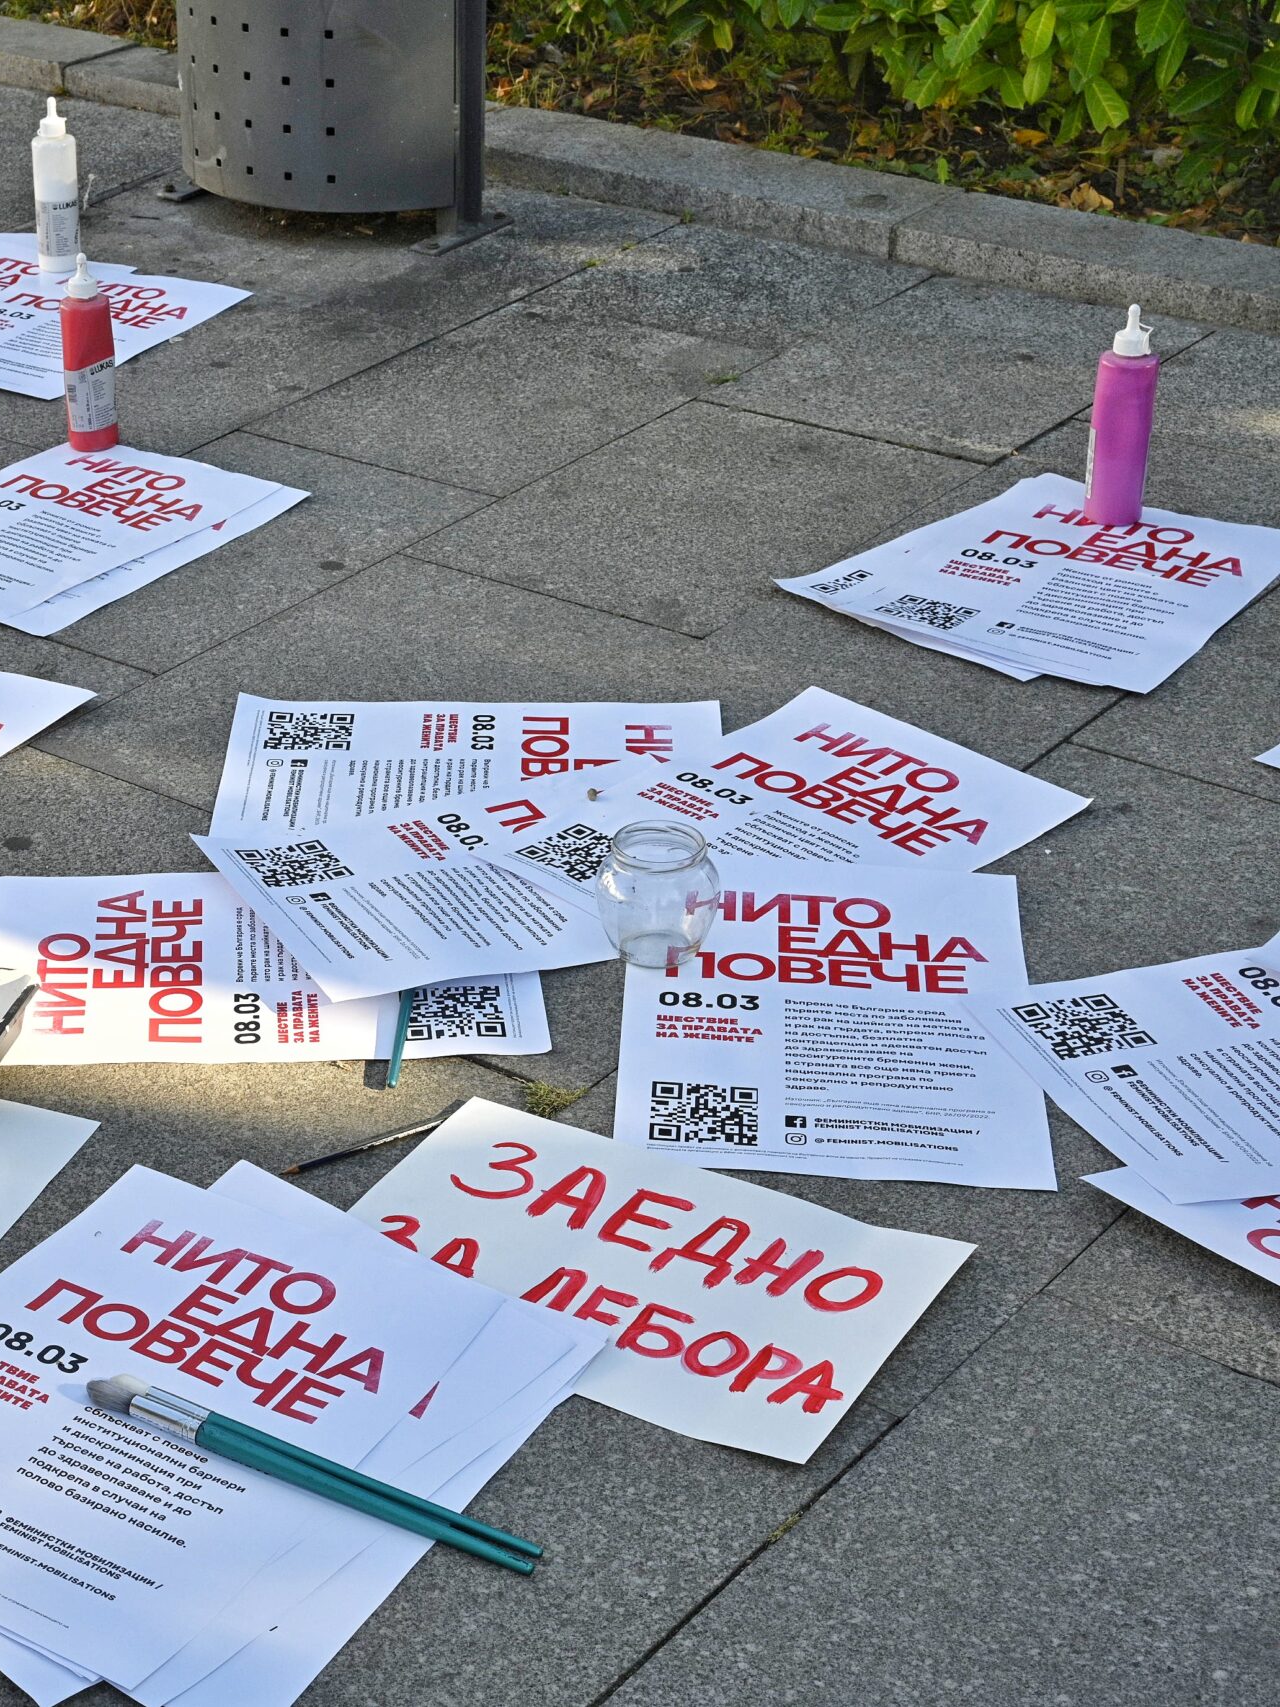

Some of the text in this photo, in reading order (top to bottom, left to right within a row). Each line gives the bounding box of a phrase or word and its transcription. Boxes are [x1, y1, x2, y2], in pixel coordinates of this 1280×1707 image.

[94, 359, 114, 374] LUKAS
[64, 454, 186, 492] НИТО
[89, 477, 205, 521] ЕДНА
[949, 560, 1009, 574] ШЕСТВИЕ
[960, 548, 1036, 570] 08.03
[981, 530, 1221, 588] ПОВЕЧЕ
[1082, 531, 1244, 577] ЕДНА
[954, 573, 1011, 586] ЖЕНИТЕ
[962, 568, 1020, 583] ПРАВАТА
[420, 714, 433, 748] НА ЖЕНИТЕ
[433, 714, 446, 751] ЗА ПРАВАТА
[448, 714, 459, 743] ШЕСТВИЕ
[471, 714, 495, 750] 08.03
[521, 716, 571, 782] ПОВ
[793, 722, 960, 793] НИТО
[637, 791, 706, 821] НА ЖЕНИТЕ
[647, 787, 720, 818] ЗА ПРАВАТА
[656, 782, 715, 807] ШЕСТВИЕ
[676, 772, 754, 805] 08.03
[710, 751, 952, 857] ПОВЕЧЕ
[823, 765, 990, 846] ЕДНА
[387, 825, 431, 860] НА ЖЕНИТЕ
[400, 822, 446, 862] ЗА ПРАВАТА
[412, 820, 450, 851] ШЕСТВИЕ
[437, 813, 489, 851] 08.0
[684, 890, 891, 930] НИТО
[92, 889, 150, 989] ЕДНА
[777, 924, 989, 965] ЕДНА
[33, 932, 91, 1035] НИТО
[149, 899, 203, 1043] ПОВЕЧЕ
[666, 944, 970, 995] ПОВЕЧЕ
[658, 990, 761, 1012] 08.03
[785, 999, 833, 1007] Въпреки
[852, 1005, 905, 1013] България
[1181, 978, 1243, 1028] НА ЖЕНИТЕ
[1196, 976, 1261, 1030] ЗА ПРАВАТА
[1210, 972, 1263, 1014] ШЕСТВИЕ
[234, 993, 261, 1044] 08.03
[277, 1002, 289, 1043] ШЕСТВИЕ
[292, 990, 305, 1043] ЗА ПРАВАТА
[307, 993, 320, 1043] НА ЖЕНИТЕ
[657, 1015, 738, 1025] ШЕСТВИЕ
[682, 1025, 763, 1035] ПРАВАТА
[888, 1015, 961, 1023] заболявания
[683, 1033, 754, 1043] ЖЕНИТЕ
[815, 1118, 888, 1127] ФЕМИНИСТКИ
[889, 1123, 972, 1134] МОБИЛИЗАЦИИ
[864, 1126, 946, 1136] MOBILISATIONS
[1110, 1091, 1184, 1157] FEMINIST.MOBILISATIONS
[1126, 1081, 1200, 1147] FEMINIST MOBILISATIONS
[1135, 1080, 1178, 1119] ФЕМИНИСТКИ
[1175, 1116, 1225, 1160] МОБИЛИЗАЦИИ
[827, 1139, 958, 1151] FEMINIST.MOBILISATIONS
[449, 1141, 884, 1313] ЗАЕДНО
[120, 1218, 337, 1315] НИТО
[24, 1278, 345, 1425] ПОВЕЧЕ
[168, 1286, 387, 1395] ЕДНА
[73, 1416, 246, 1493] институционални бариери
[84, 1404, 151, 1437] сблъскват
[162, 1440, 208, 1463] повече
[38, 1447, 56, 1456] до
[58, 1454, 161, 1503] здравеопазване
[172, 1507, 192, 1516] до
[52, 1436, 223, 1514] търсене на работа, достъп
[71, 1431, 175, 1478] дискриминация
[176, 1477, 202, 1490] при
[17, 1467, 186, 1548] полово базирано насилие.
[28, 1456, 90, 1488] подкрепа
[102, 1490, 148, 1513] случаи
[149, 1511, 166, 1521] на
[2, 1517, 76, 1550] ФЕМИНИСТКИ
[70, 1548, 155, 1586] МОБИЛИЗАЦИИ
[43, 1542, 125, 1579] MOBILISATIONS
